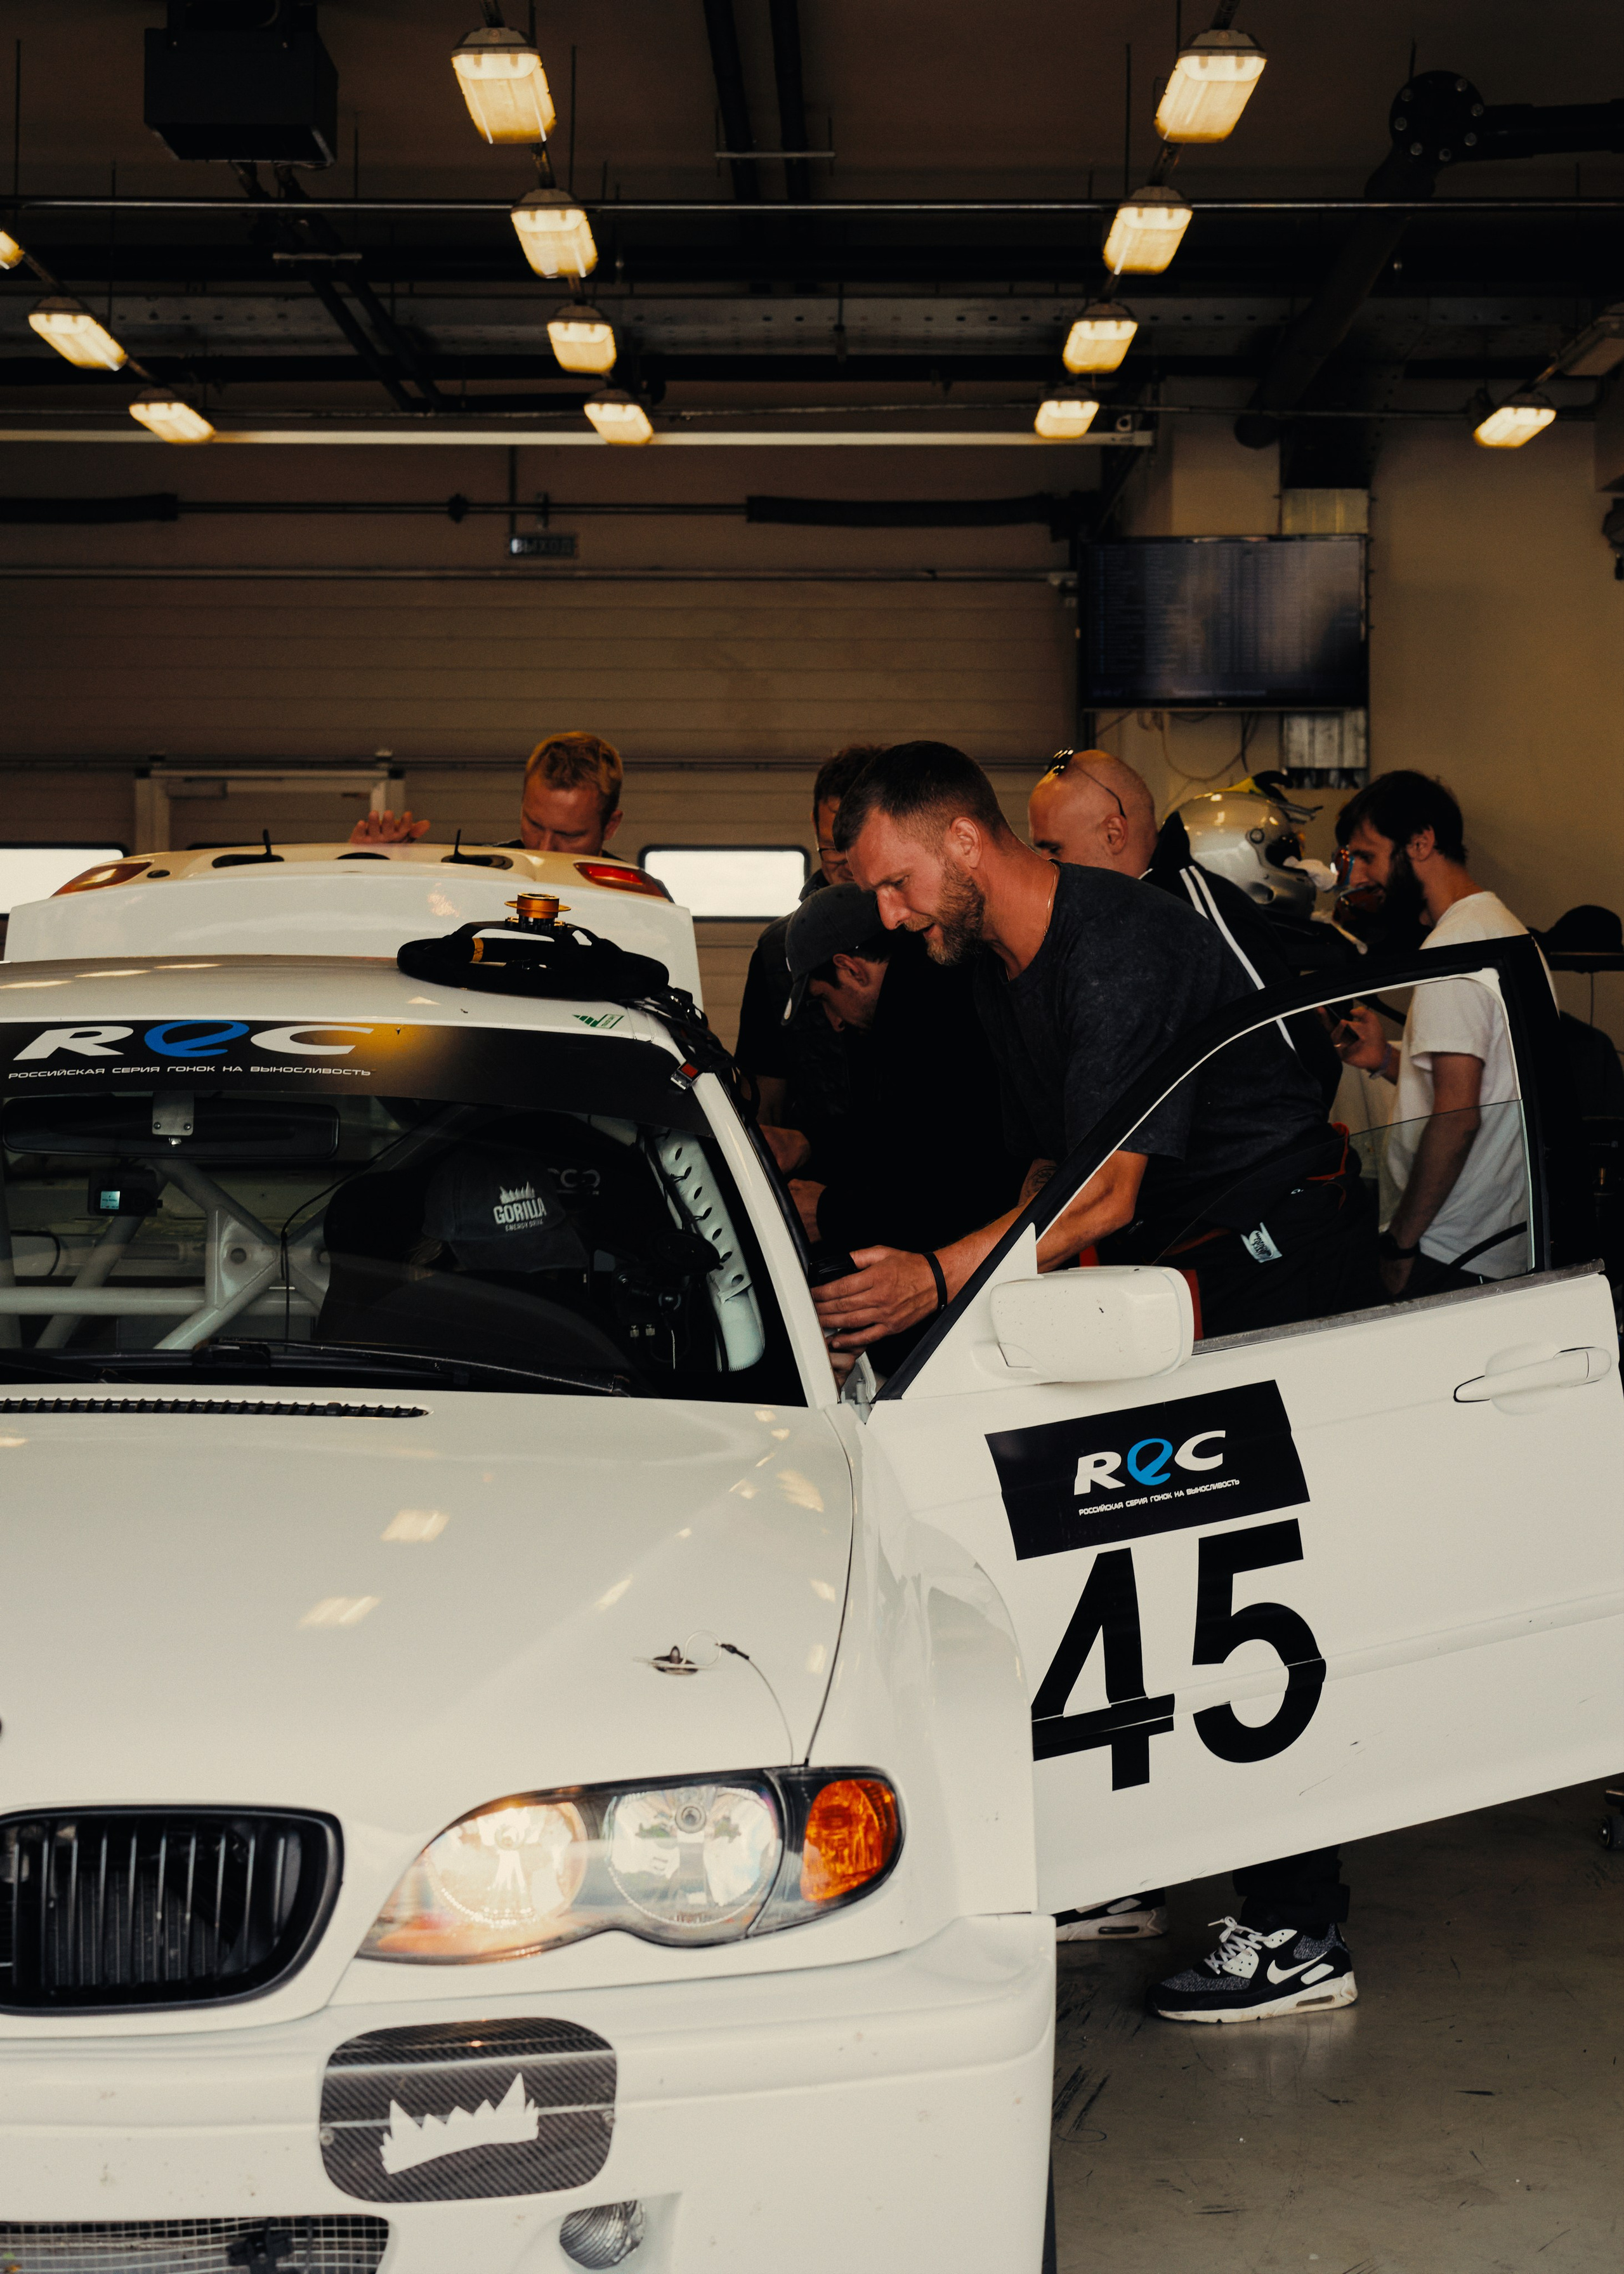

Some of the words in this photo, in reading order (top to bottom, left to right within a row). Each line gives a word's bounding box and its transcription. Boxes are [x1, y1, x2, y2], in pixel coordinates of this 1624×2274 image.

[8, 1068, 105, 1079] РОССИЙСКАЯ
[250, 1067, 371, 1075] ВЫНОСЛИВОСТЬ
[493, 1197, 547, 1225] GORILLA
[505, 1221, 528, 1232] ENERGY
[1078, 1501, 1123, 1516] РОССИЙСКАЯ
[1125, 1497, 1148, 1508] СЕРИЯ
[1149, 1492, 1173, 1502] ГОНОК
[1174, 1489, 1185, 1498] НА
[1186, 1479, 1240, 1495] ВЫНОСЛИВОСТЬ
[1031, 1518, 1326, 1791] 45
